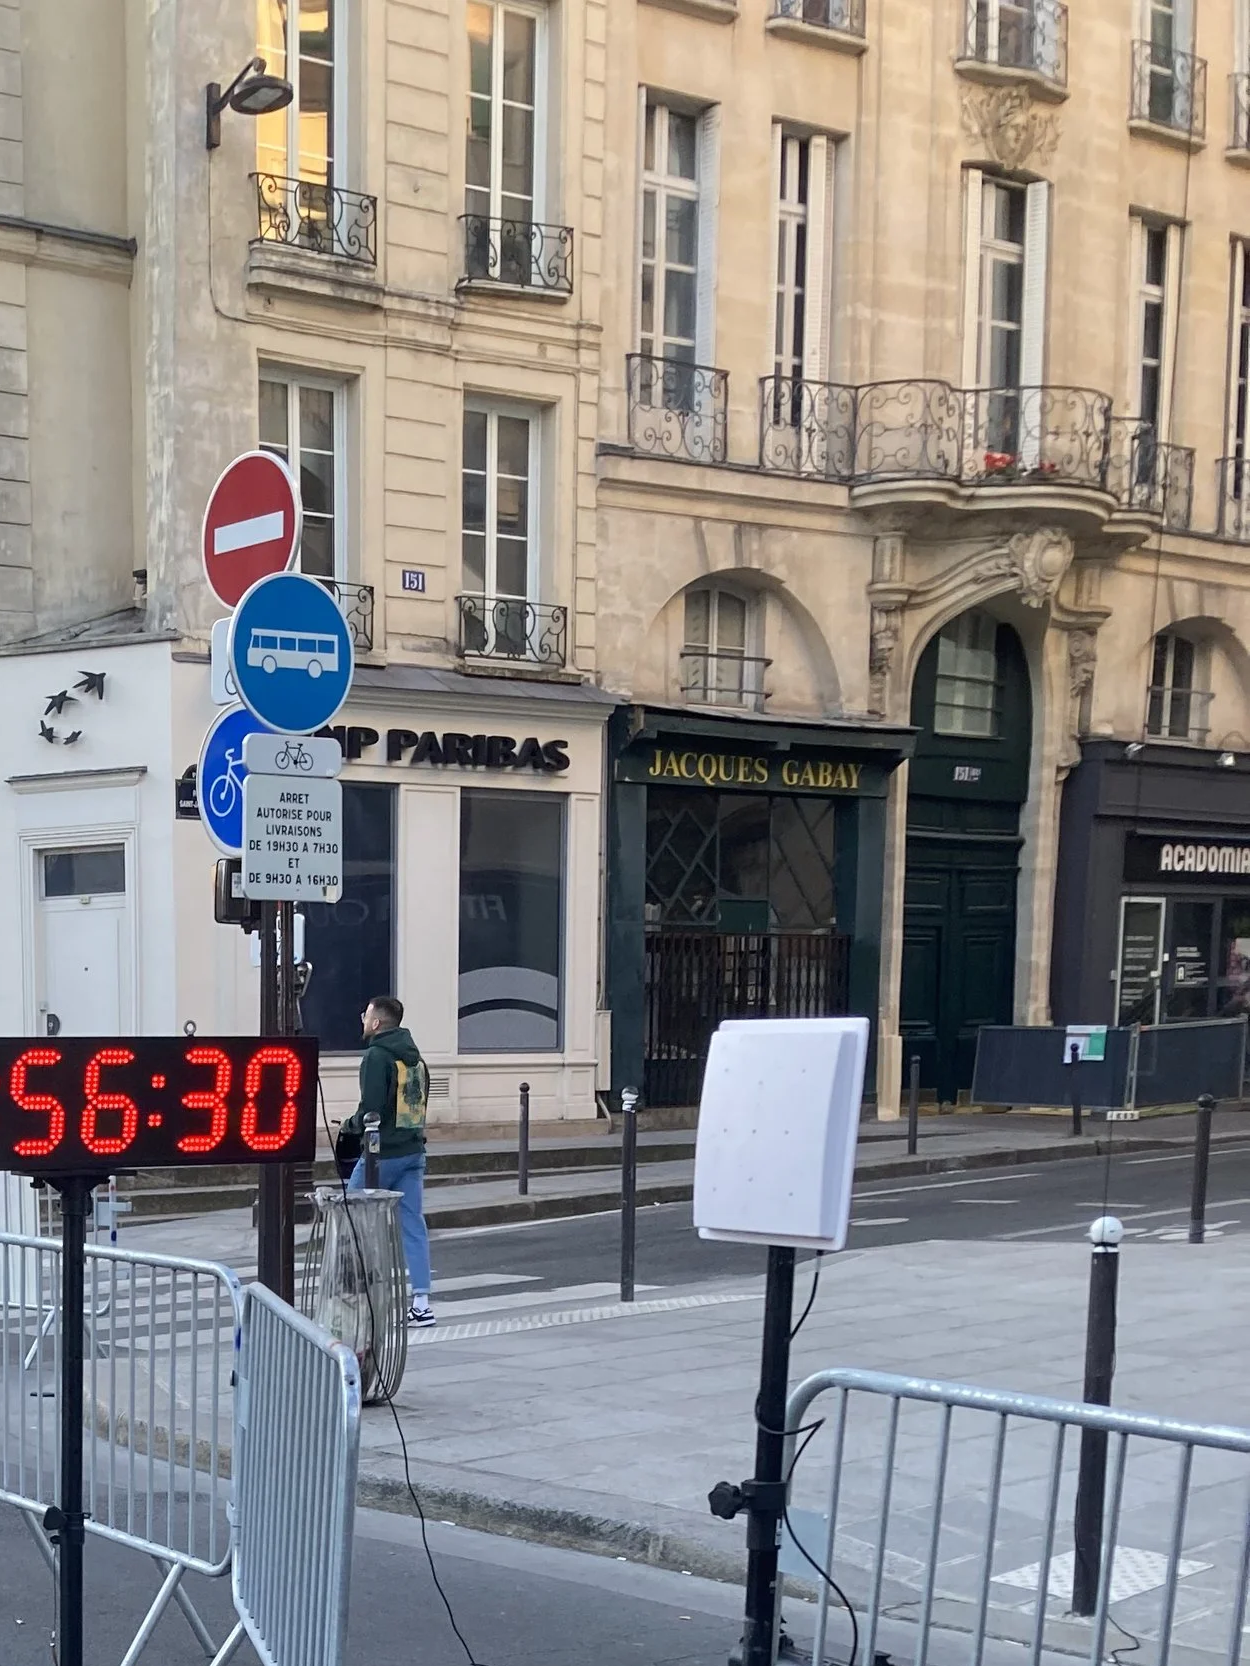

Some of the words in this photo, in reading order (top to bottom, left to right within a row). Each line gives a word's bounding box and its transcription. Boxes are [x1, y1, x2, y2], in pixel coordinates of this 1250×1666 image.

[404, 572, 423, 590] 151
[314, 724, 379, 759] NP
[387, 729, 570, 771] PARIBAS
[649, 750, 770, 786] JACQUES
[782, 759, 863, 789] GABAY
[279, 792, 310, 805] ARRET
[256, 807, 304, 820] AUTORISE
[306, 810, 332, 822] POUR
[266, 824, 323, 837] LIVRAISONS
[249, 839, 262, 851] DE
[267, 840, 299, 853] 19H30
[302, 842, 309, 854] A
[313, 842, 339, 854] 7H30
[288, 857, 300, 869] ET
[1161, 844, 1250, 873] ACADOMIA
[248, 872, 261, 884] DE
[265, 873, 292, 885] 9H30
[295, 874, 302, 885] A
[307, 875, 339, 887] 16H30
